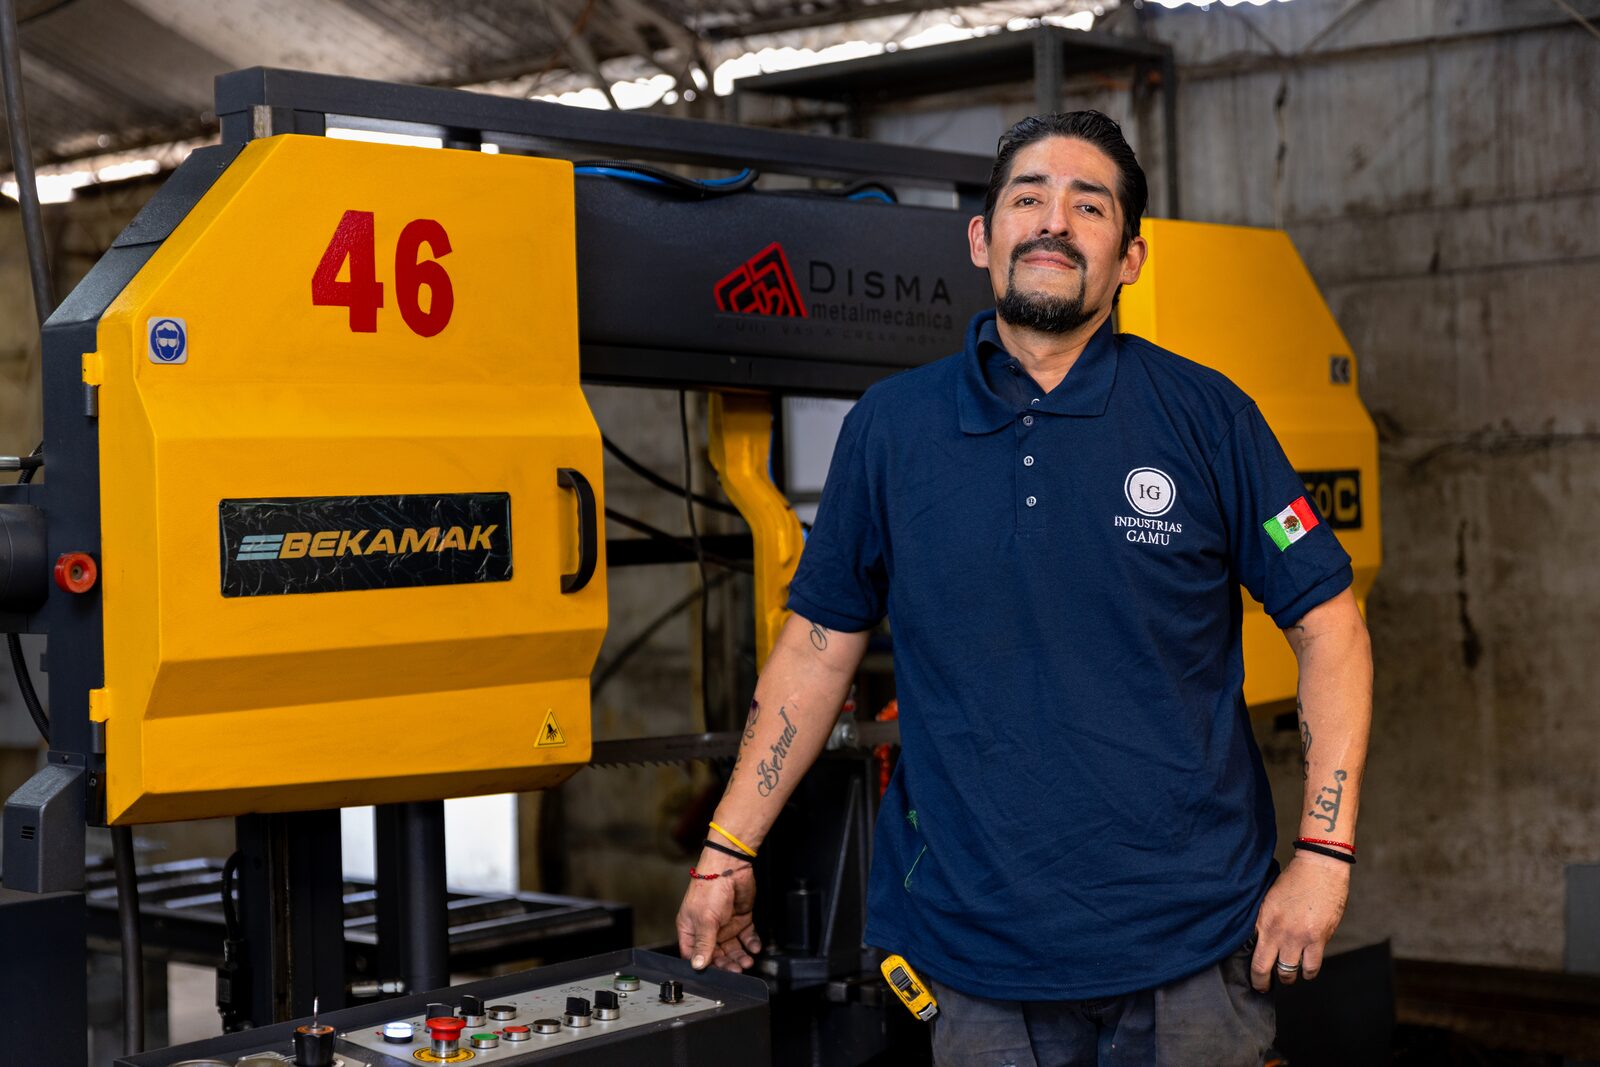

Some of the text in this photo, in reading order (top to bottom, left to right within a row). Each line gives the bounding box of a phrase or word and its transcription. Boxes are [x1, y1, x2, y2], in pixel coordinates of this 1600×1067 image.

[311, 209, 454, 338] 46
[808, 260, 952, 305] DISMA
[1139, 484, 1161, 500] IG
[1114, 515, 1182, 533] INDUSTRIAS
[279, 525, 498, 559] BEKAMAK
[1126, 530, 1170, 546] GAMU
